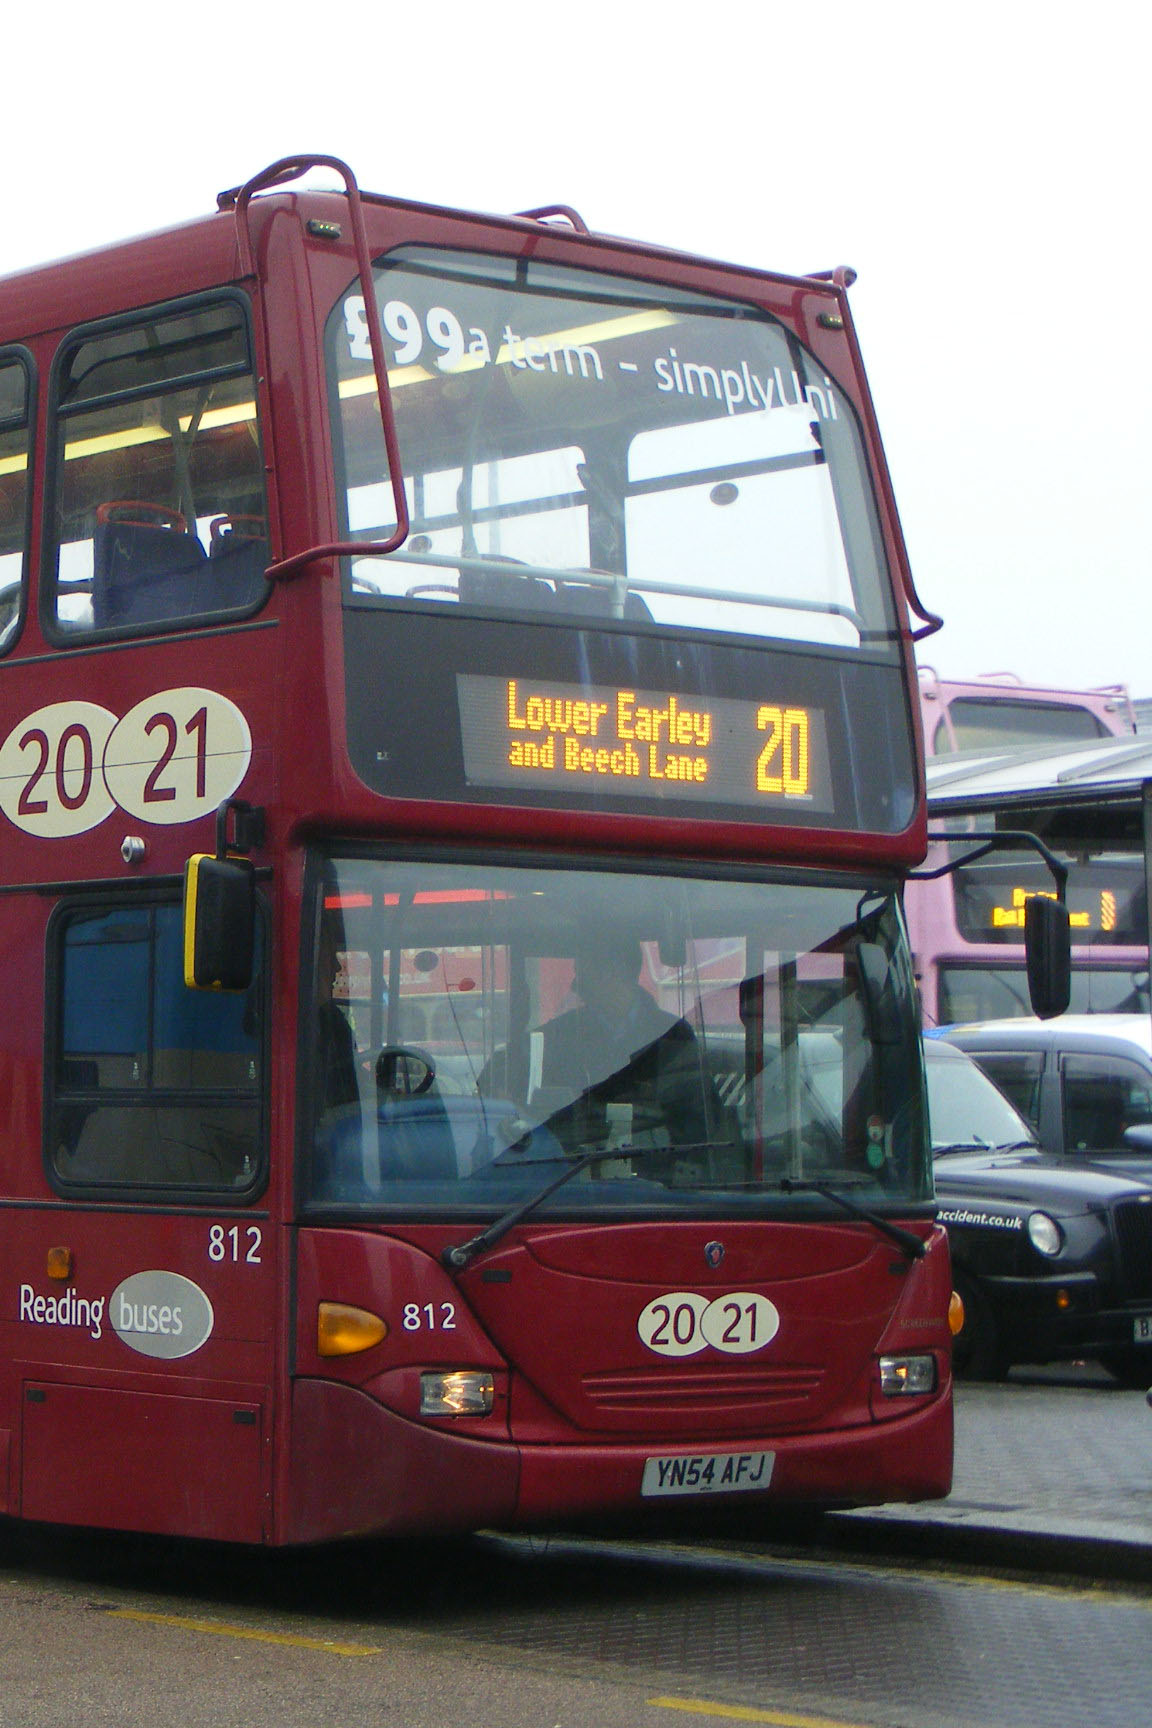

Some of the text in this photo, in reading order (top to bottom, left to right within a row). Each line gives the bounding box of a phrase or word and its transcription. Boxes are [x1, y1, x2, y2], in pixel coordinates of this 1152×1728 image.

[343, 295, 466, 374] £99
[468, 328, 491, 363] a
[502, 324, 604, 381] term
[508, 681, 710, 746] Lower Earley
[18, 723, 92, 816] 20
[144, 707, 207, 802] 21
[509, 735, 708, 782] and Beech Lane
[756, 706, 808, 795] 20
[936, 1209, 1023, 1230] accident.co.uk
[208, 1225, 262, 1263] 812
[20, 1284, 184, 1339] Reading buses
[402, 1302, 456, 1330] 812
[650, 1303, 695, 1345] 20
[722, 1302, 758, 1343] 21
[658, 1455, 766, 1487] YN54 AFJ
